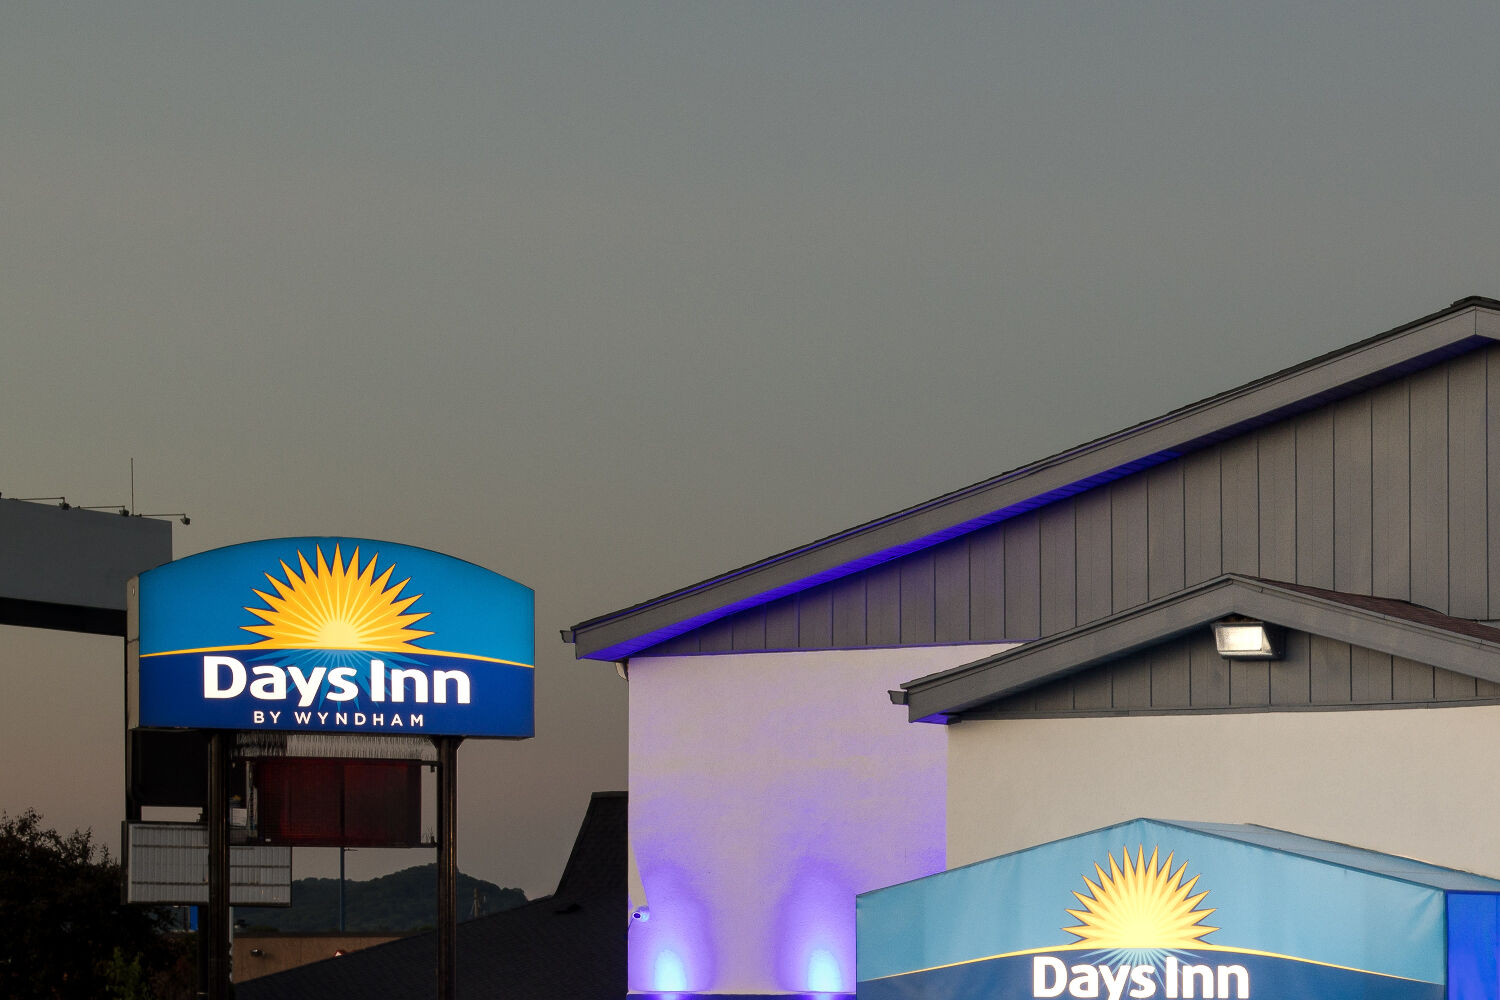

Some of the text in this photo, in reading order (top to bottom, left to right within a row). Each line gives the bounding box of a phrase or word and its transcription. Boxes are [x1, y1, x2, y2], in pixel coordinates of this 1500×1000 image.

[202, 655, 472, 707] Days Inn
[253, 710, 425, 727] BY WYNDHAM
[1165, 956, 1250, 1000] Inn
